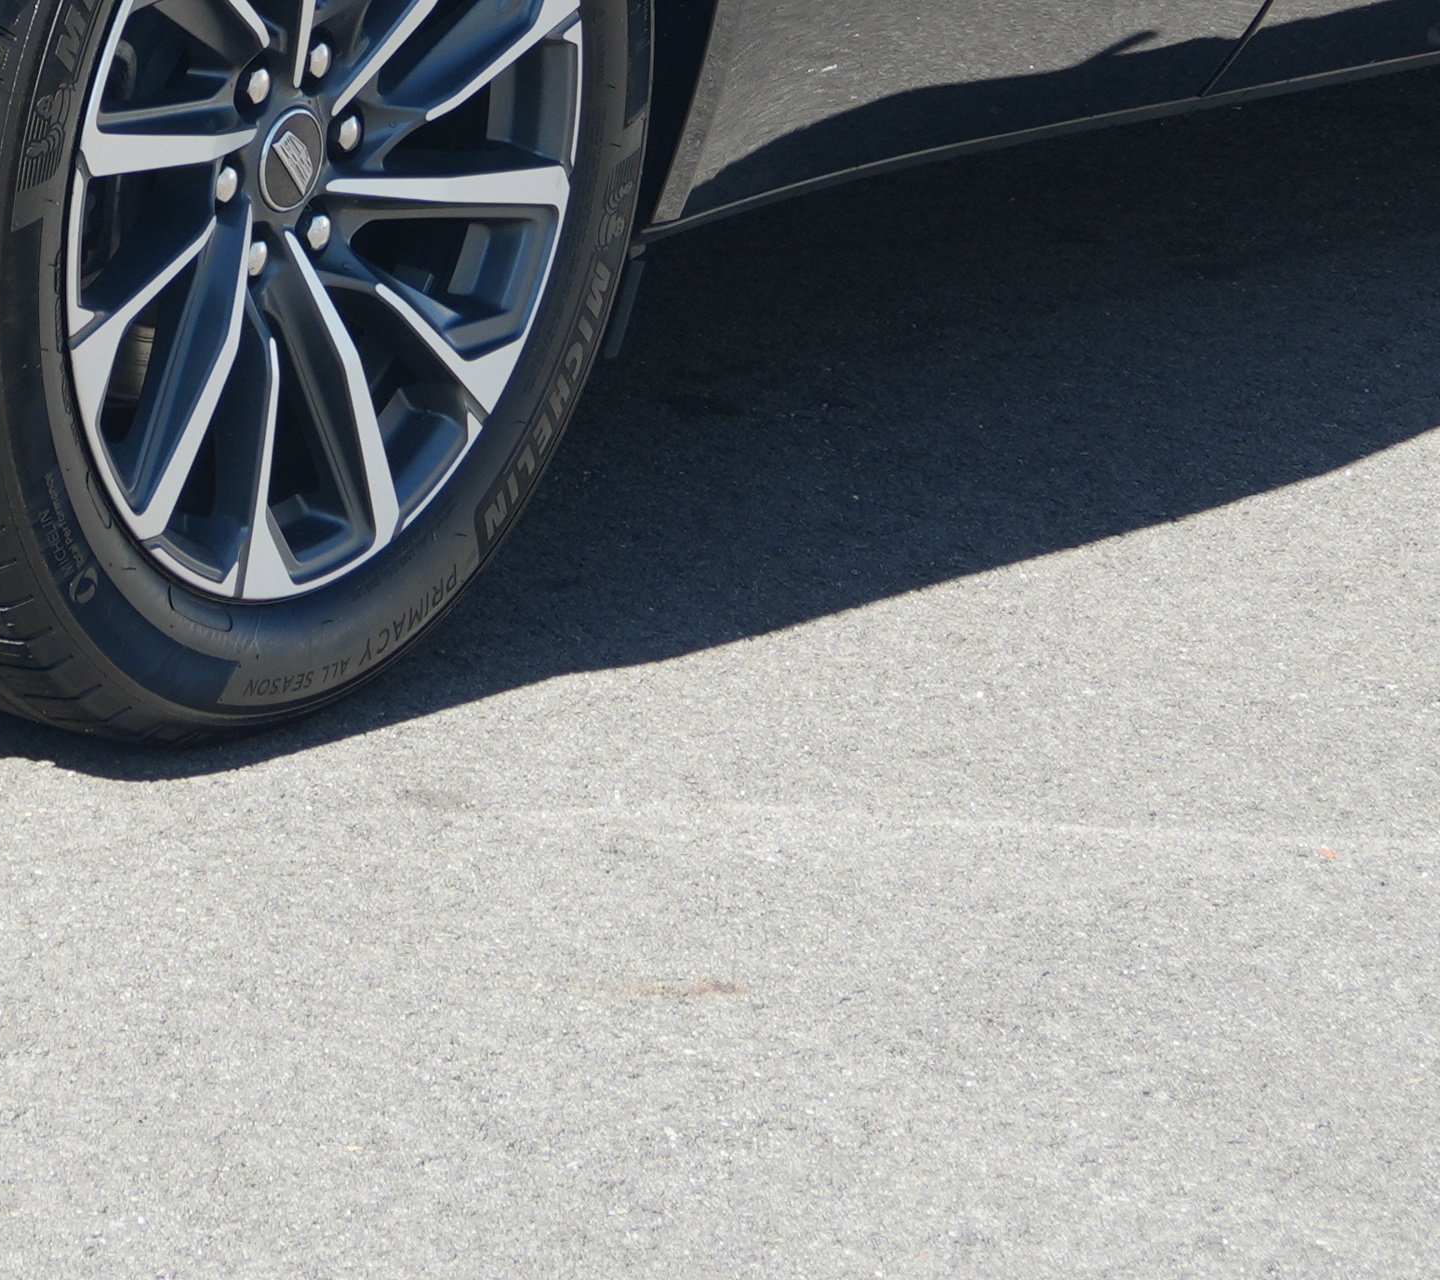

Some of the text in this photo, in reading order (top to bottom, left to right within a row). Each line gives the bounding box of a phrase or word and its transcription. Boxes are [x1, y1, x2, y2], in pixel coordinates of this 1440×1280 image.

[483, 260, 611, 541] MICHELIN
[38, 508, 74, 578] MICHELIN
[243, 563, 458, 698] PRIMACY ALL SEASON
